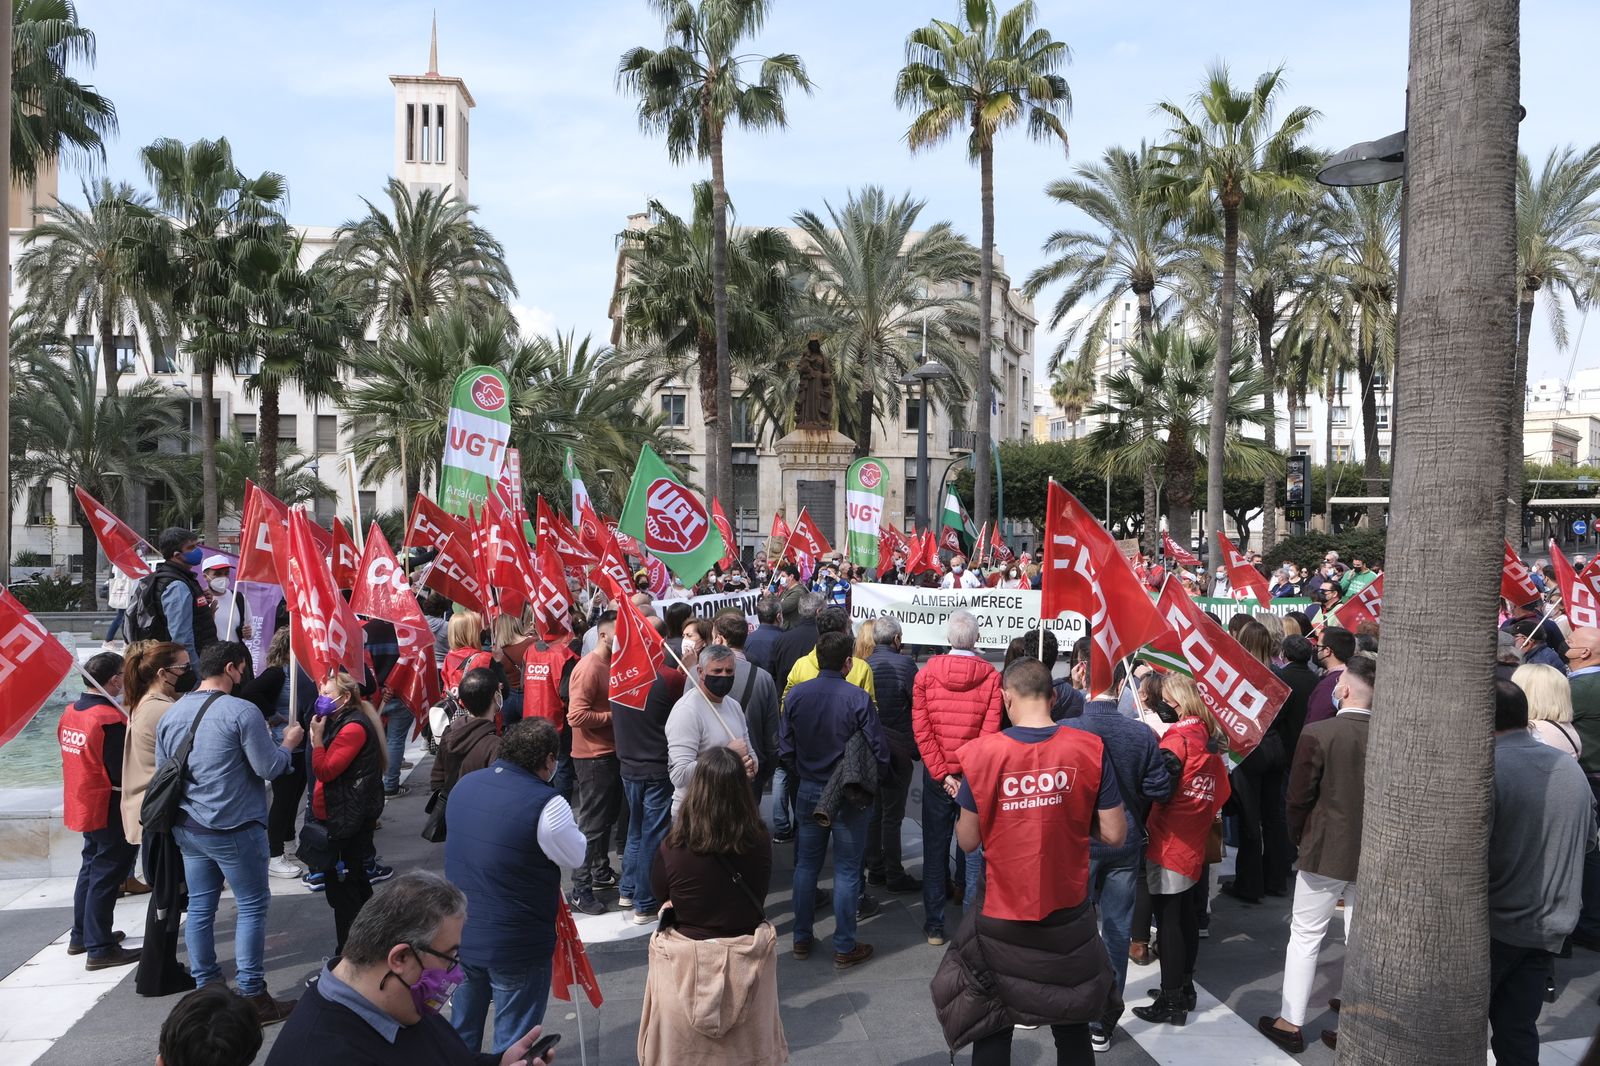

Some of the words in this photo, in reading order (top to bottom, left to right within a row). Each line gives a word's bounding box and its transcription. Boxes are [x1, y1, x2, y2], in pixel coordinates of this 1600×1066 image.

[450, 426, 506, 462] UGT
[648, 482, 707, 538] UGT
[852, 605, 878, 620] UNA
[880, 608, 935, 625] SANIDAD
[997, 616, 1004, 628] Y
[1008, 616, 1024, 629] DE
[1028, 616, 1082, 631] CALIDAD
[911, 592, 966, 608] ALMERÍA
[971, 595, 1023, 609] MERECE
[1196, 681, 1248, 736] Sevilla
